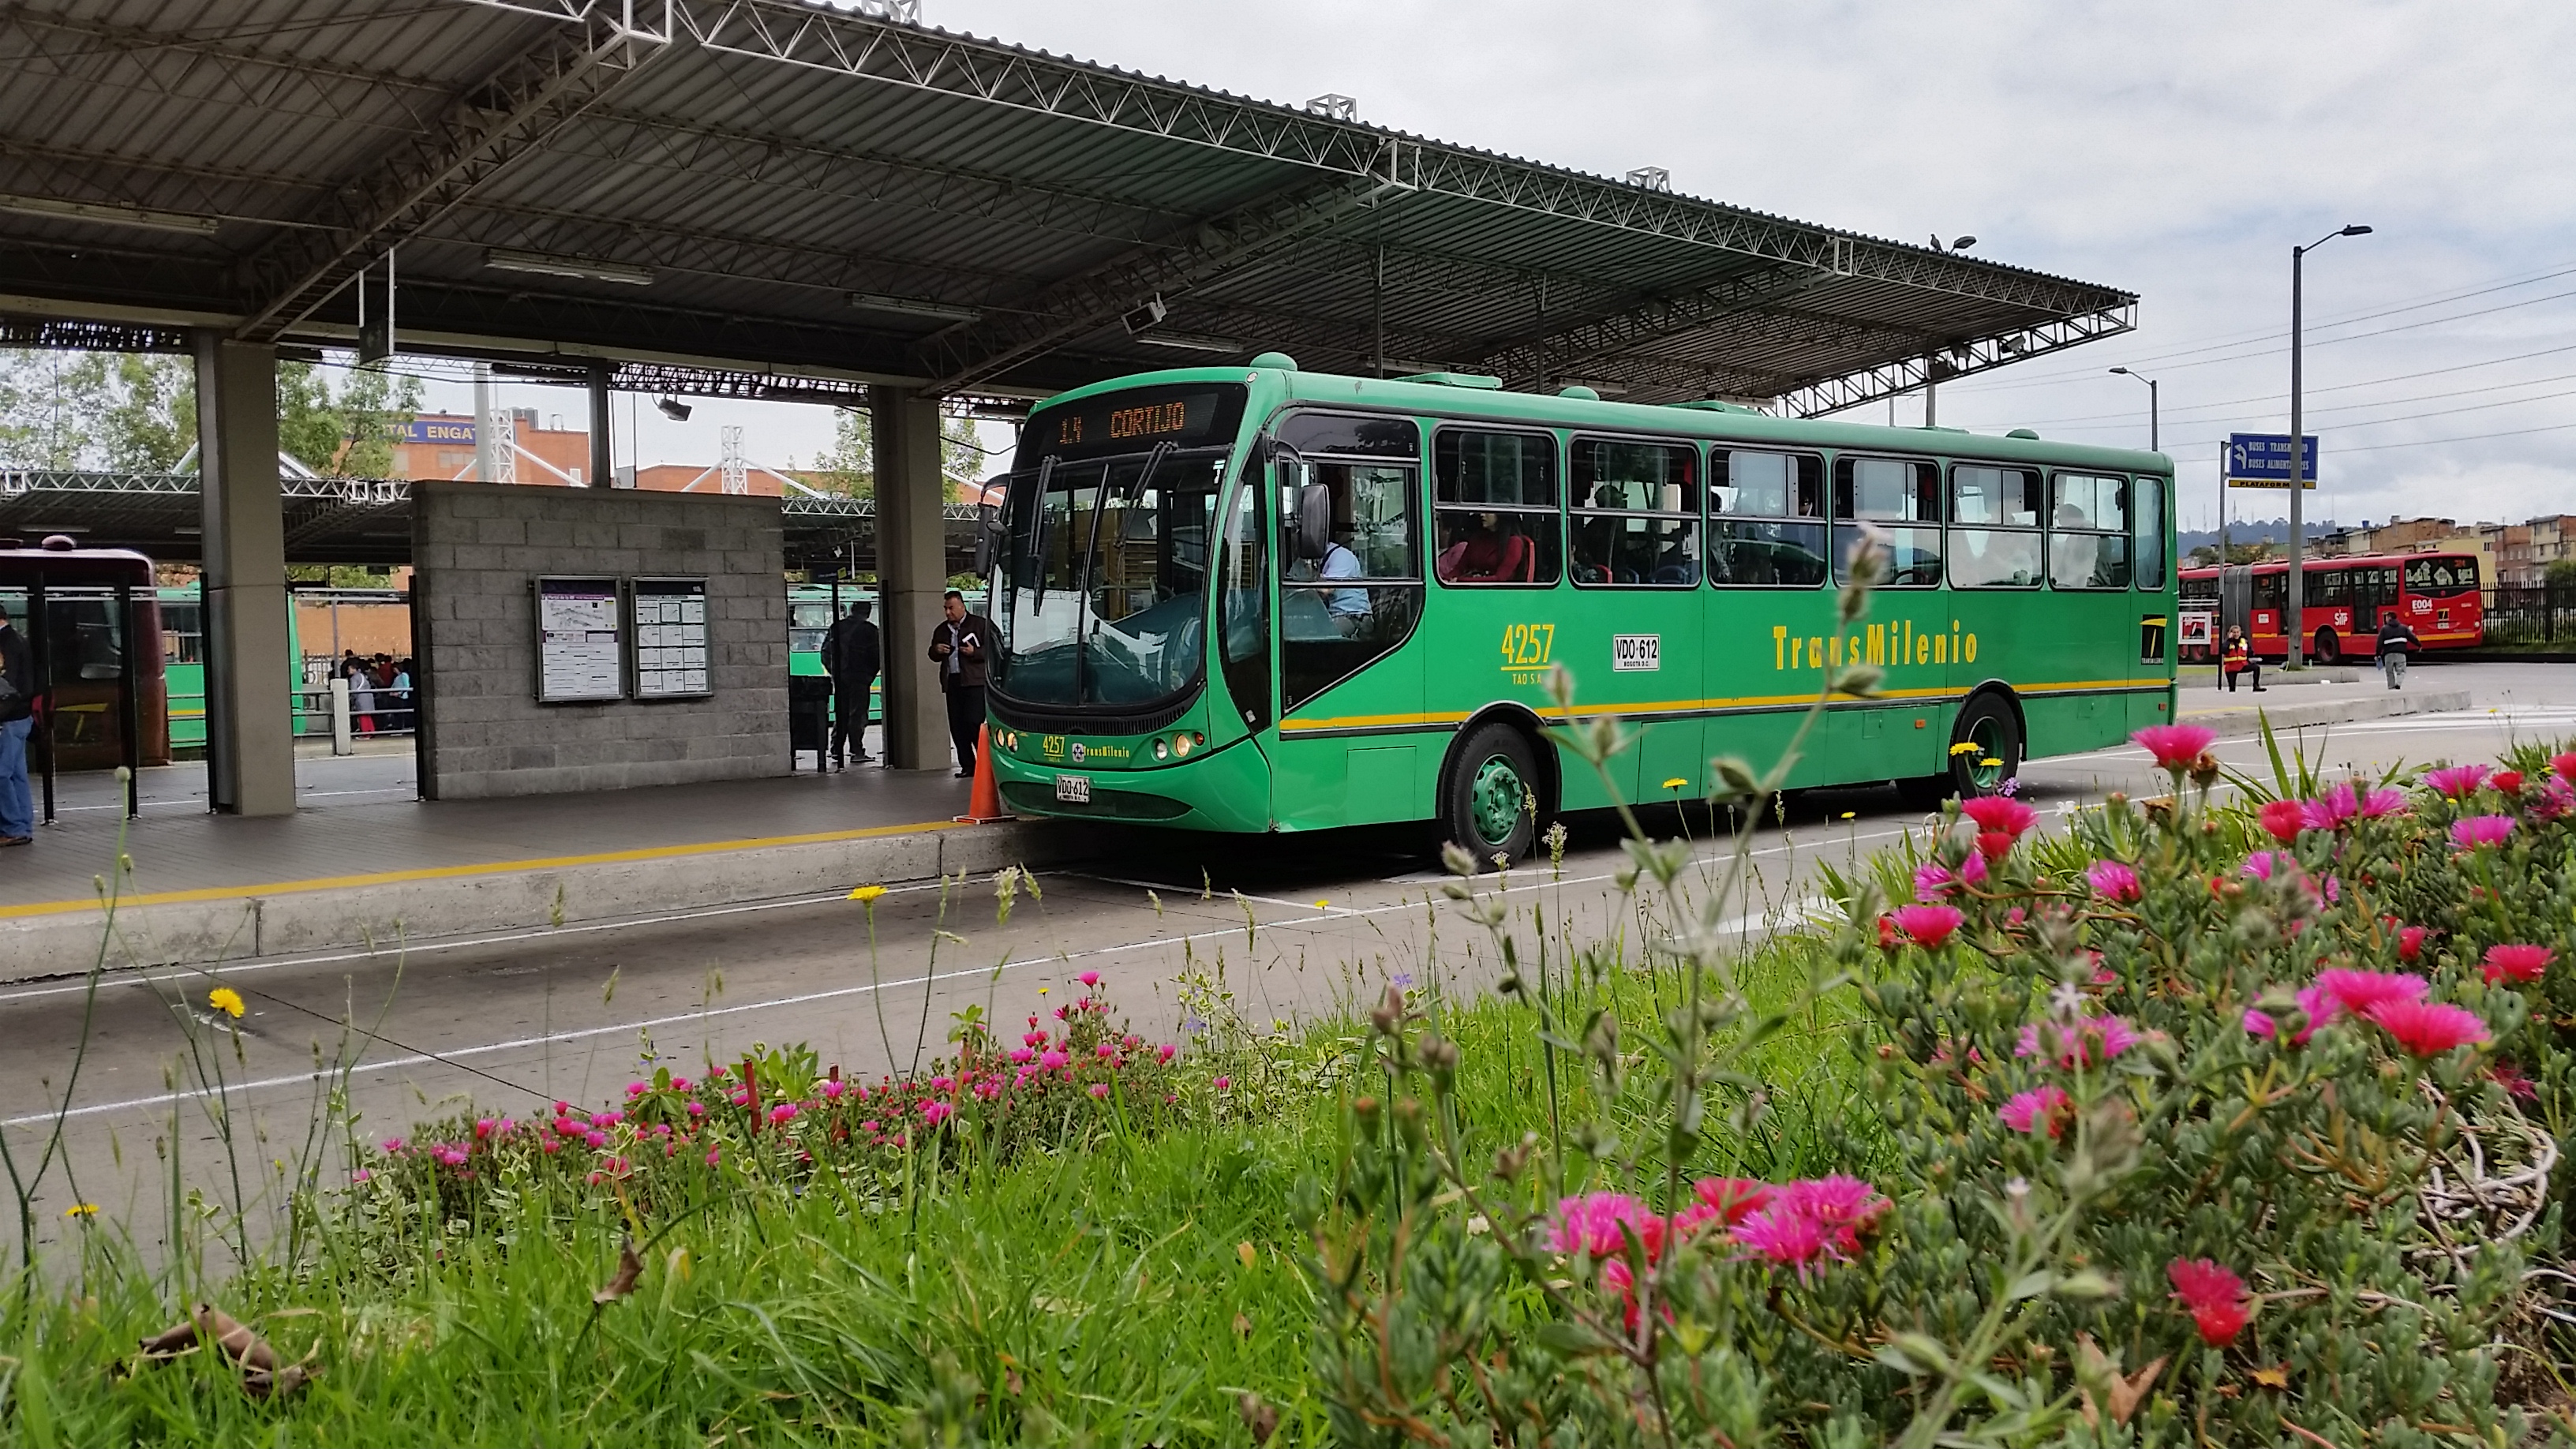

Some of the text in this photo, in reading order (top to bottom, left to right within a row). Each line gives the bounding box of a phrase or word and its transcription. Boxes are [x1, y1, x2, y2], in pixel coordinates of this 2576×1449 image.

[1110, 401, 1184, 438] CORTIJO
[427, 425, 476, 440] ENGA
[2248, 441, 2265, 452] BUSES
[2248, 459, 2265, 469] BUSES
[2412, 599, 2433, 609] E004
[1501, 623, 1556, 664] 4257
[1616, 638, 1657, 660] VDO-612
[1773, 620, 1977, 670] TransMilenio
[1512, 673, 1527, 685] TAO
[1043, 736, 1065, 754] 4257
[1084, 745, 1129, 758] TransMilenio
